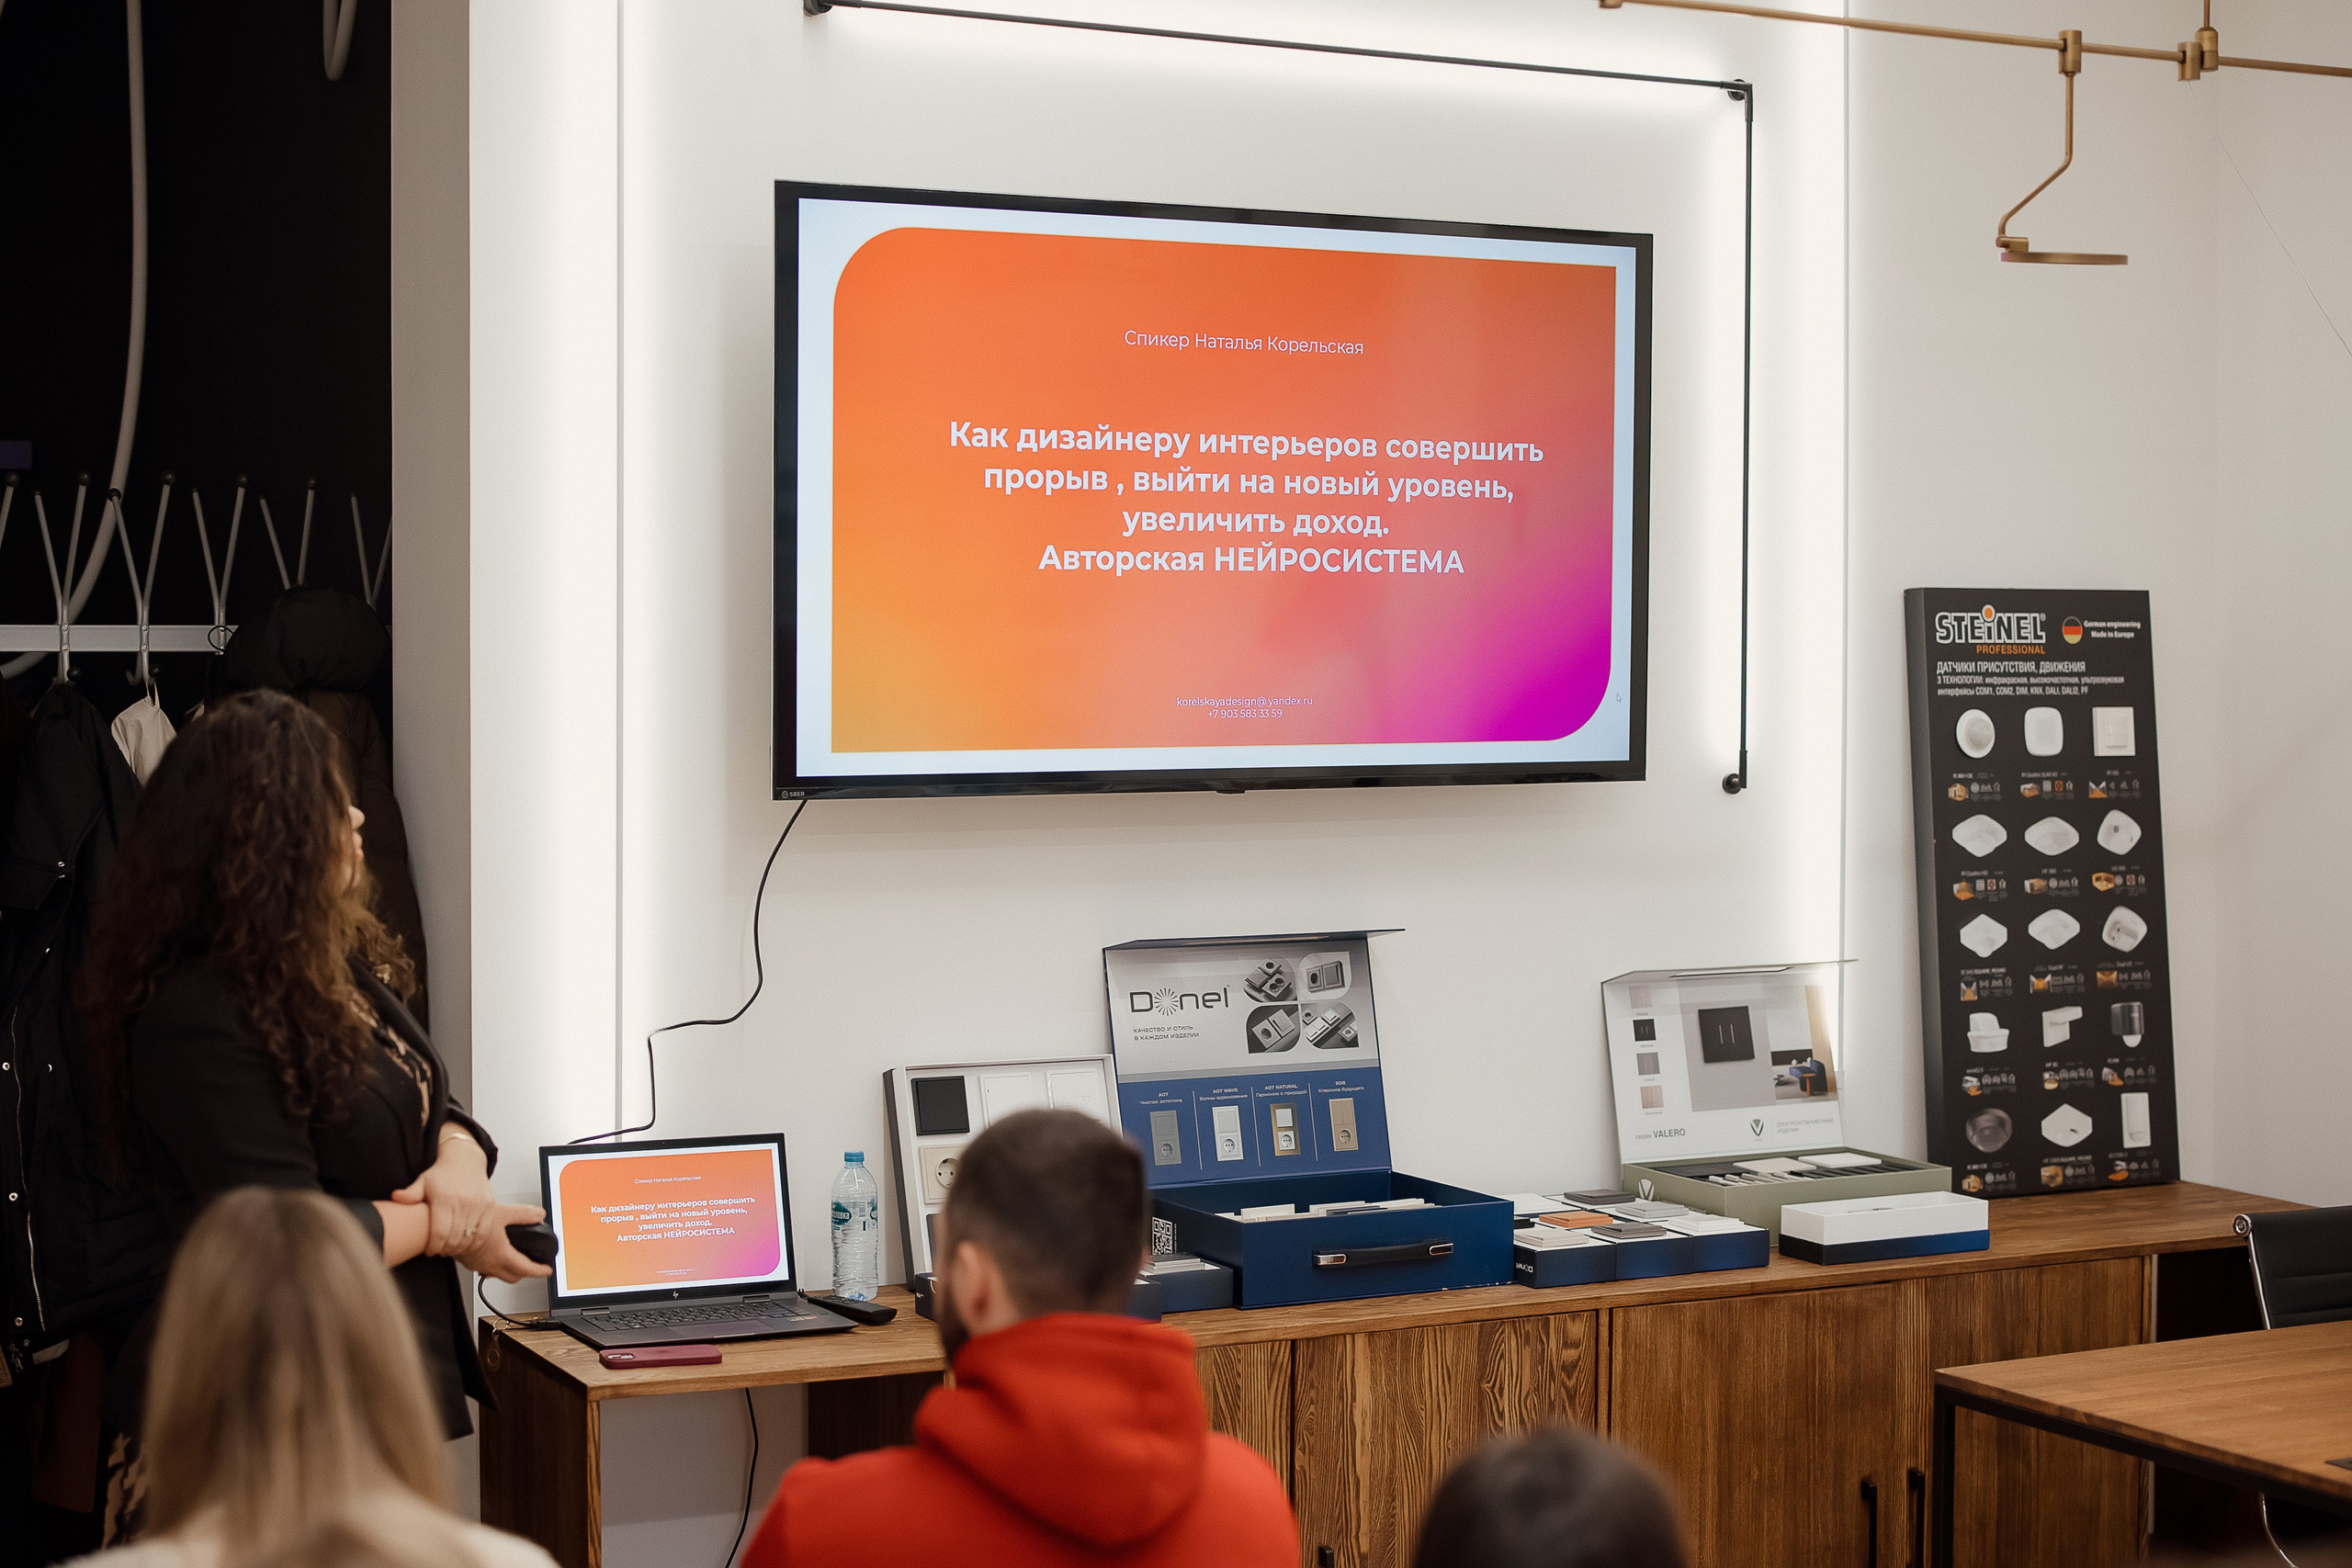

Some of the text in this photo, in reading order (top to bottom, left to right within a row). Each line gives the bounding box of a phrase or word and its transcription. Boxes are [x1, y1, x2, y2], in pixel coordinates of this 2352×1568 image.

[1124, 330, 1364, 355] Спикер Наталья Корельская
[950, 421, 1544, 466] Как дизайнеру интерьеров совершить
[984, 468, 1108, 496] прорыв
[1133, 465, 1230, 493] выйти
[1239, 474, 1275, 494] на
[1283, 469, 1379, 496] новый
[1386, 477, 1514, 503] уровень,
[1122, 510, 1390, 538] увеличить доход.
[1037, 540, 1465, 577] Авторская НЕЙРОСИСТЕМА
[2084, 620, 2142, 630] German engineering
[2091, 630, 2135, 639] Made in Europe
[1976, 644, 2046, 655] PROFESSIONAL
[1936, 660, 2086, 675] ДАТЧИКИ ПРИСУТСТВИЯ, ДВИЖЕНИЯ
[1208, 709, 1283, 718] +7 903 583 33 59
[1653, 1128, 1686, 1138] VALERO
[591, 1196, 756, 1214] Как дизайнеру интерьеров совершить
[600, 1214, 635, 1224] прорыв
[640, 1212, 667, 1221] выйти
[669, 1211, 680, 1219] на
[682, 1207, 709, 1218] новый
[710, 1206, 748, 1219] уровень,
[638, 1219, 713, 1232] увеличить доход.
[616, 1226, 736, 1243] Авторская НЕЙРОСИСТЕМА
